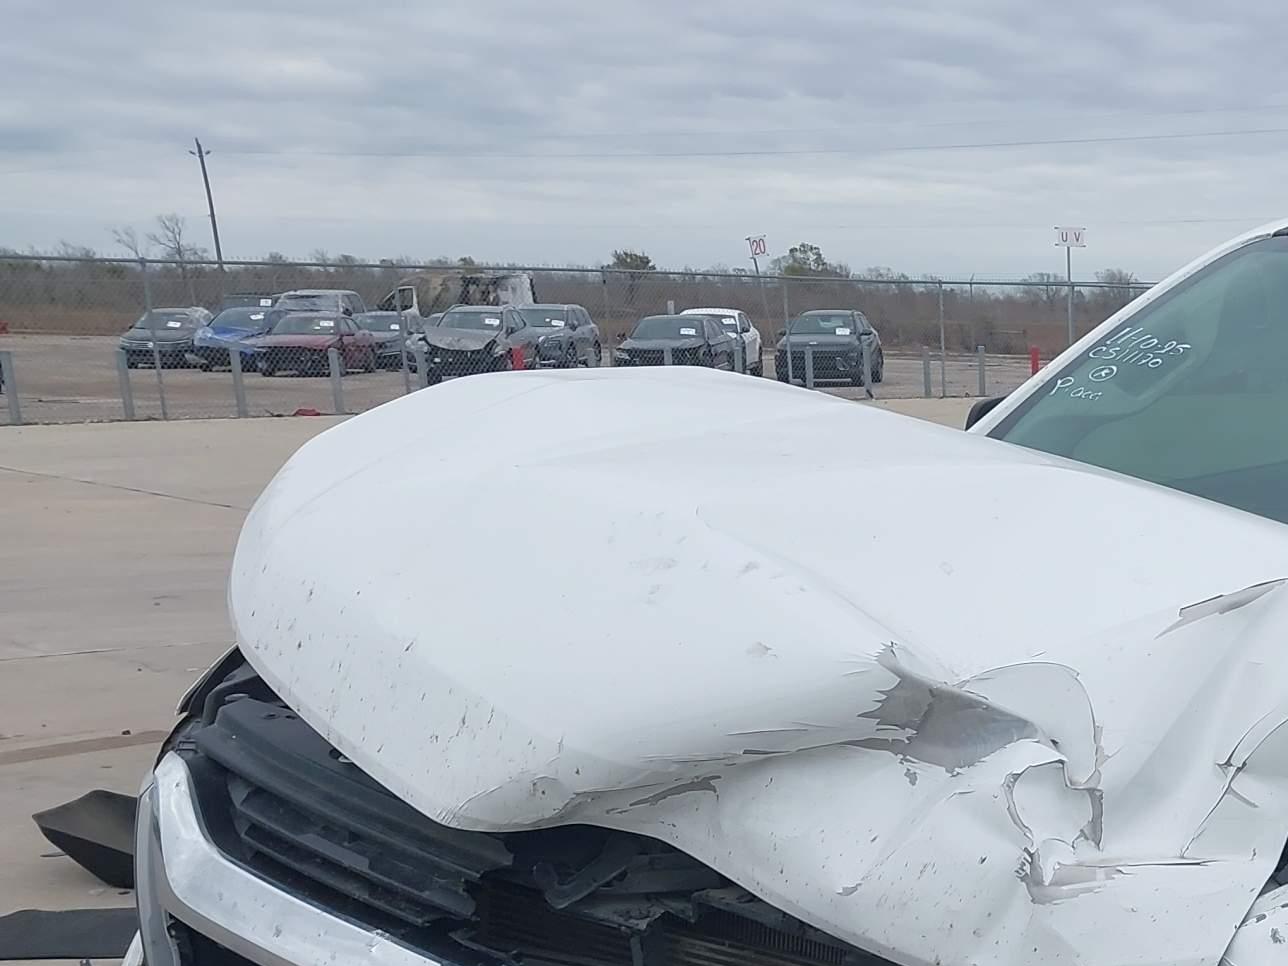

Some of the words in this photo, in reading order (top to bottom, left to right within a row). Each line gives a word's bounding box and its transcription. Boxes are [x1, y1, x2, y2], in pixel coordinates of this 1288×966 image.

[1061, 231, 1068, 243] U
[1074, 231, 1081, 243] V
[752, 239, 766, 255] 20
